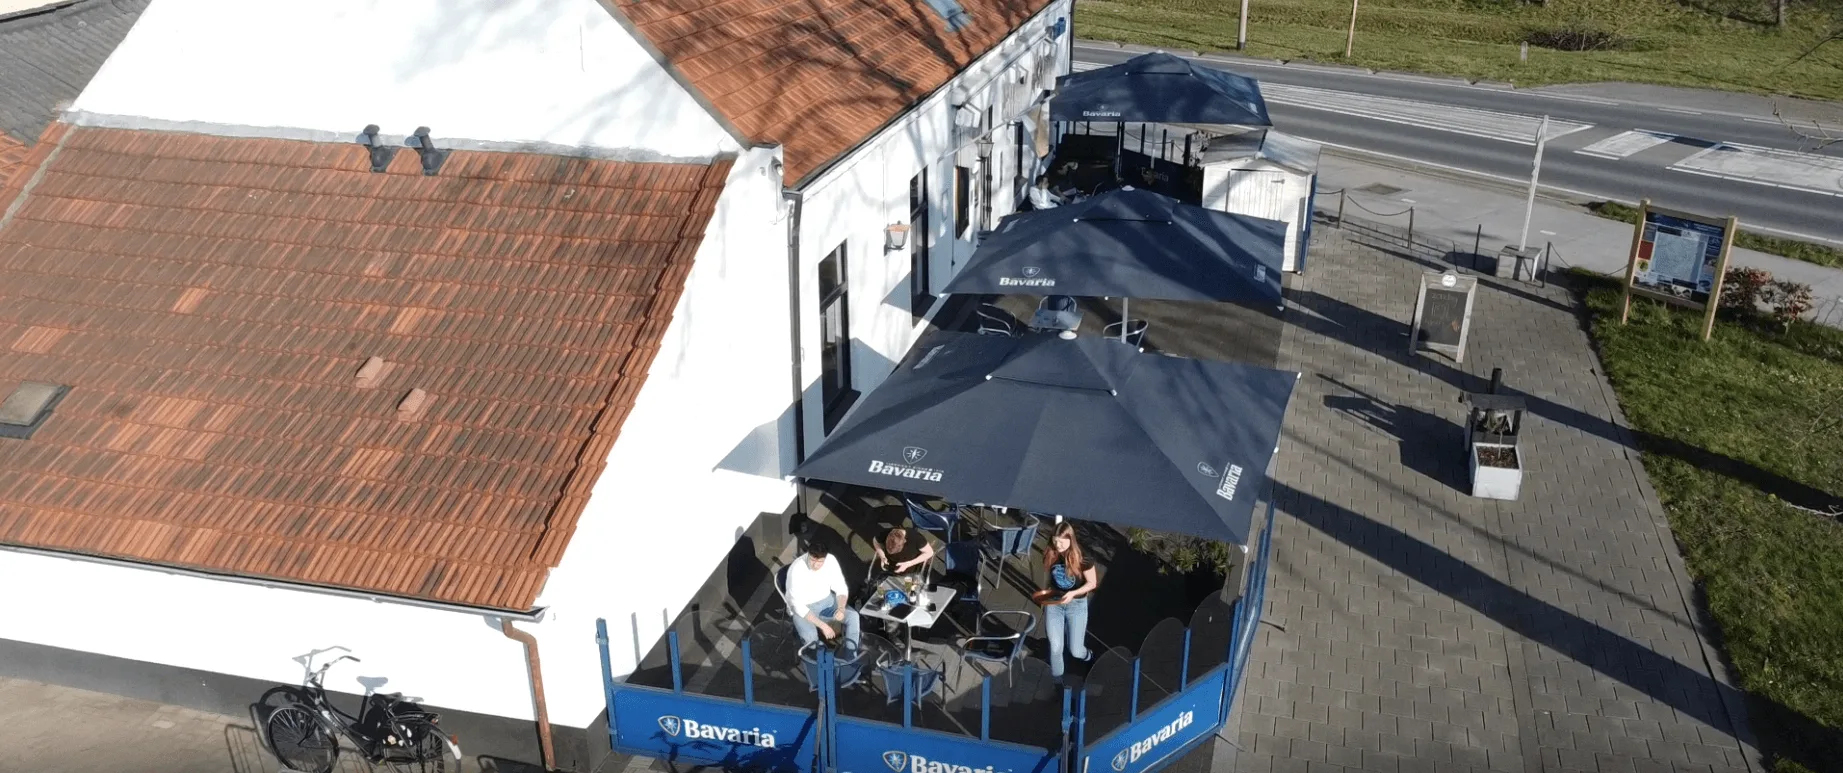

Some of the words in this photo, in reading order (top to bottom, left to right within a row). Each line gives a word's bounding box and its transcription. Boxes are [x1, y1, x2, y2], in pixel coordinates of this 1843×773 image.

[999, 277, 1056, 287] Bavaria
[868, 459, 943, 482] Bavaria
[1216, 464, 1243, 501] Bavaria
[682, 718, 776, 748] Bavaria
[1130, 710, 1194, 763] Bavaria
[909, 754, 1005, 773] Bava
